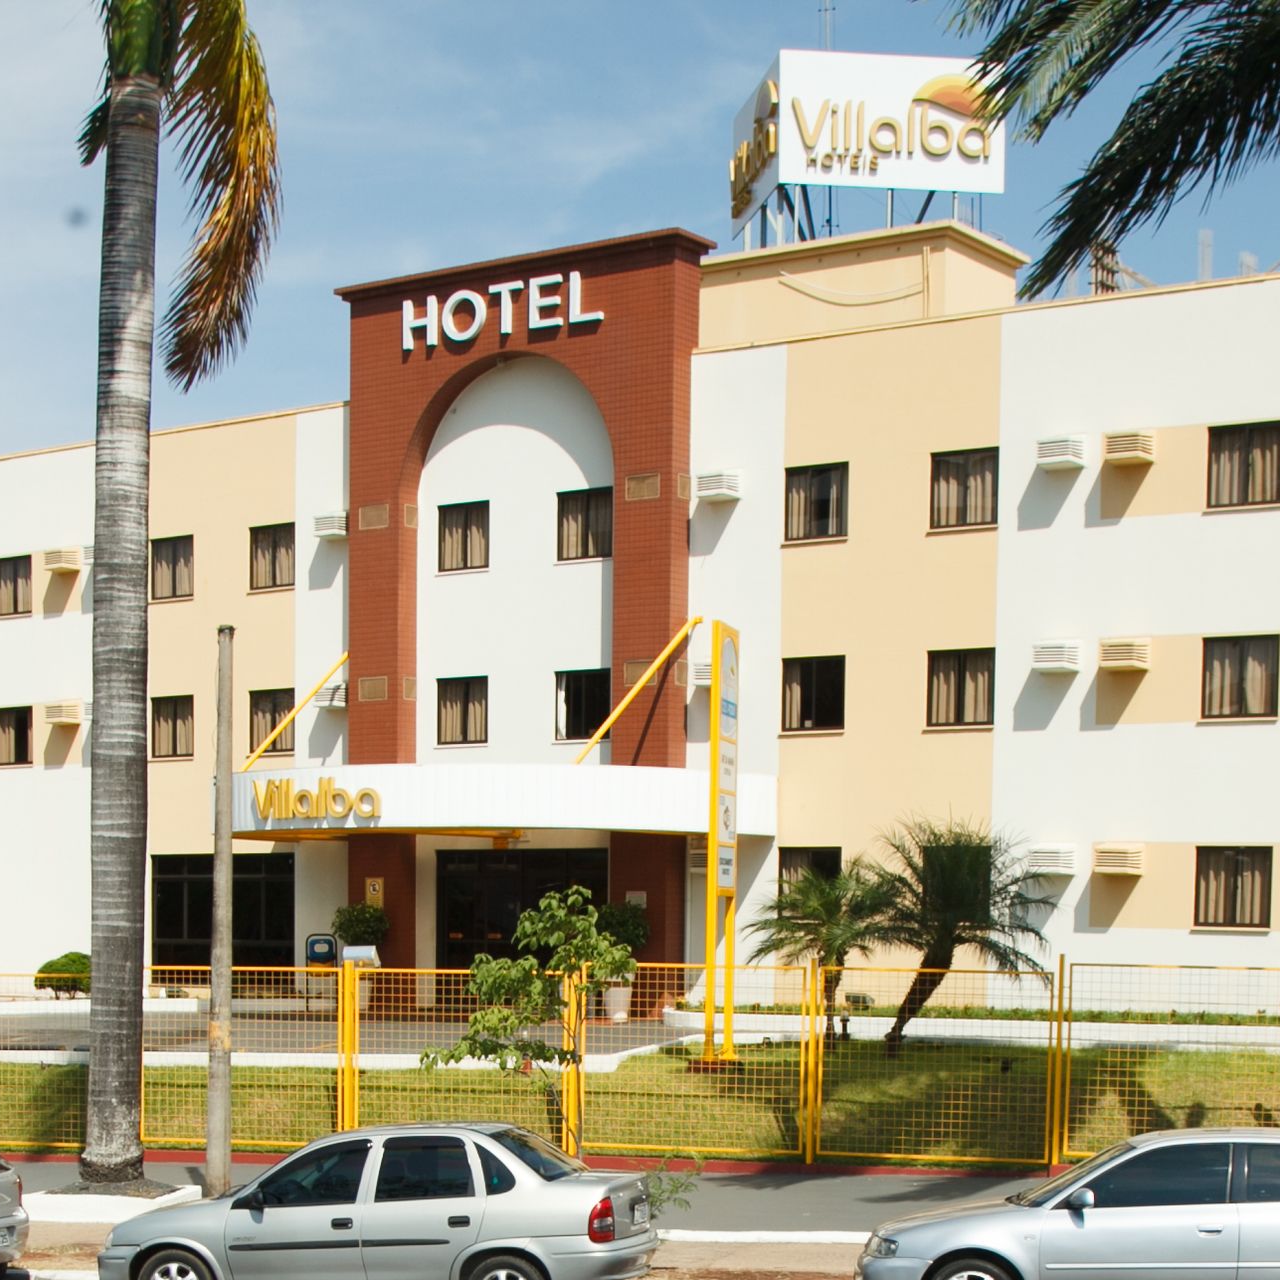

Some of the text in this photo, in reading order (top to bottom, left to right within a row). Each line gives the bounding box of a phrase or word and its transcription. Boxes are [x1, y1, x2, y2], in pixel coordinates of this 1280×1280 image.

[792, 98, 991, 158] Villalba
[402, 270, 605, 351] HOTEL
[251, 776, 383, 820] Villalba
